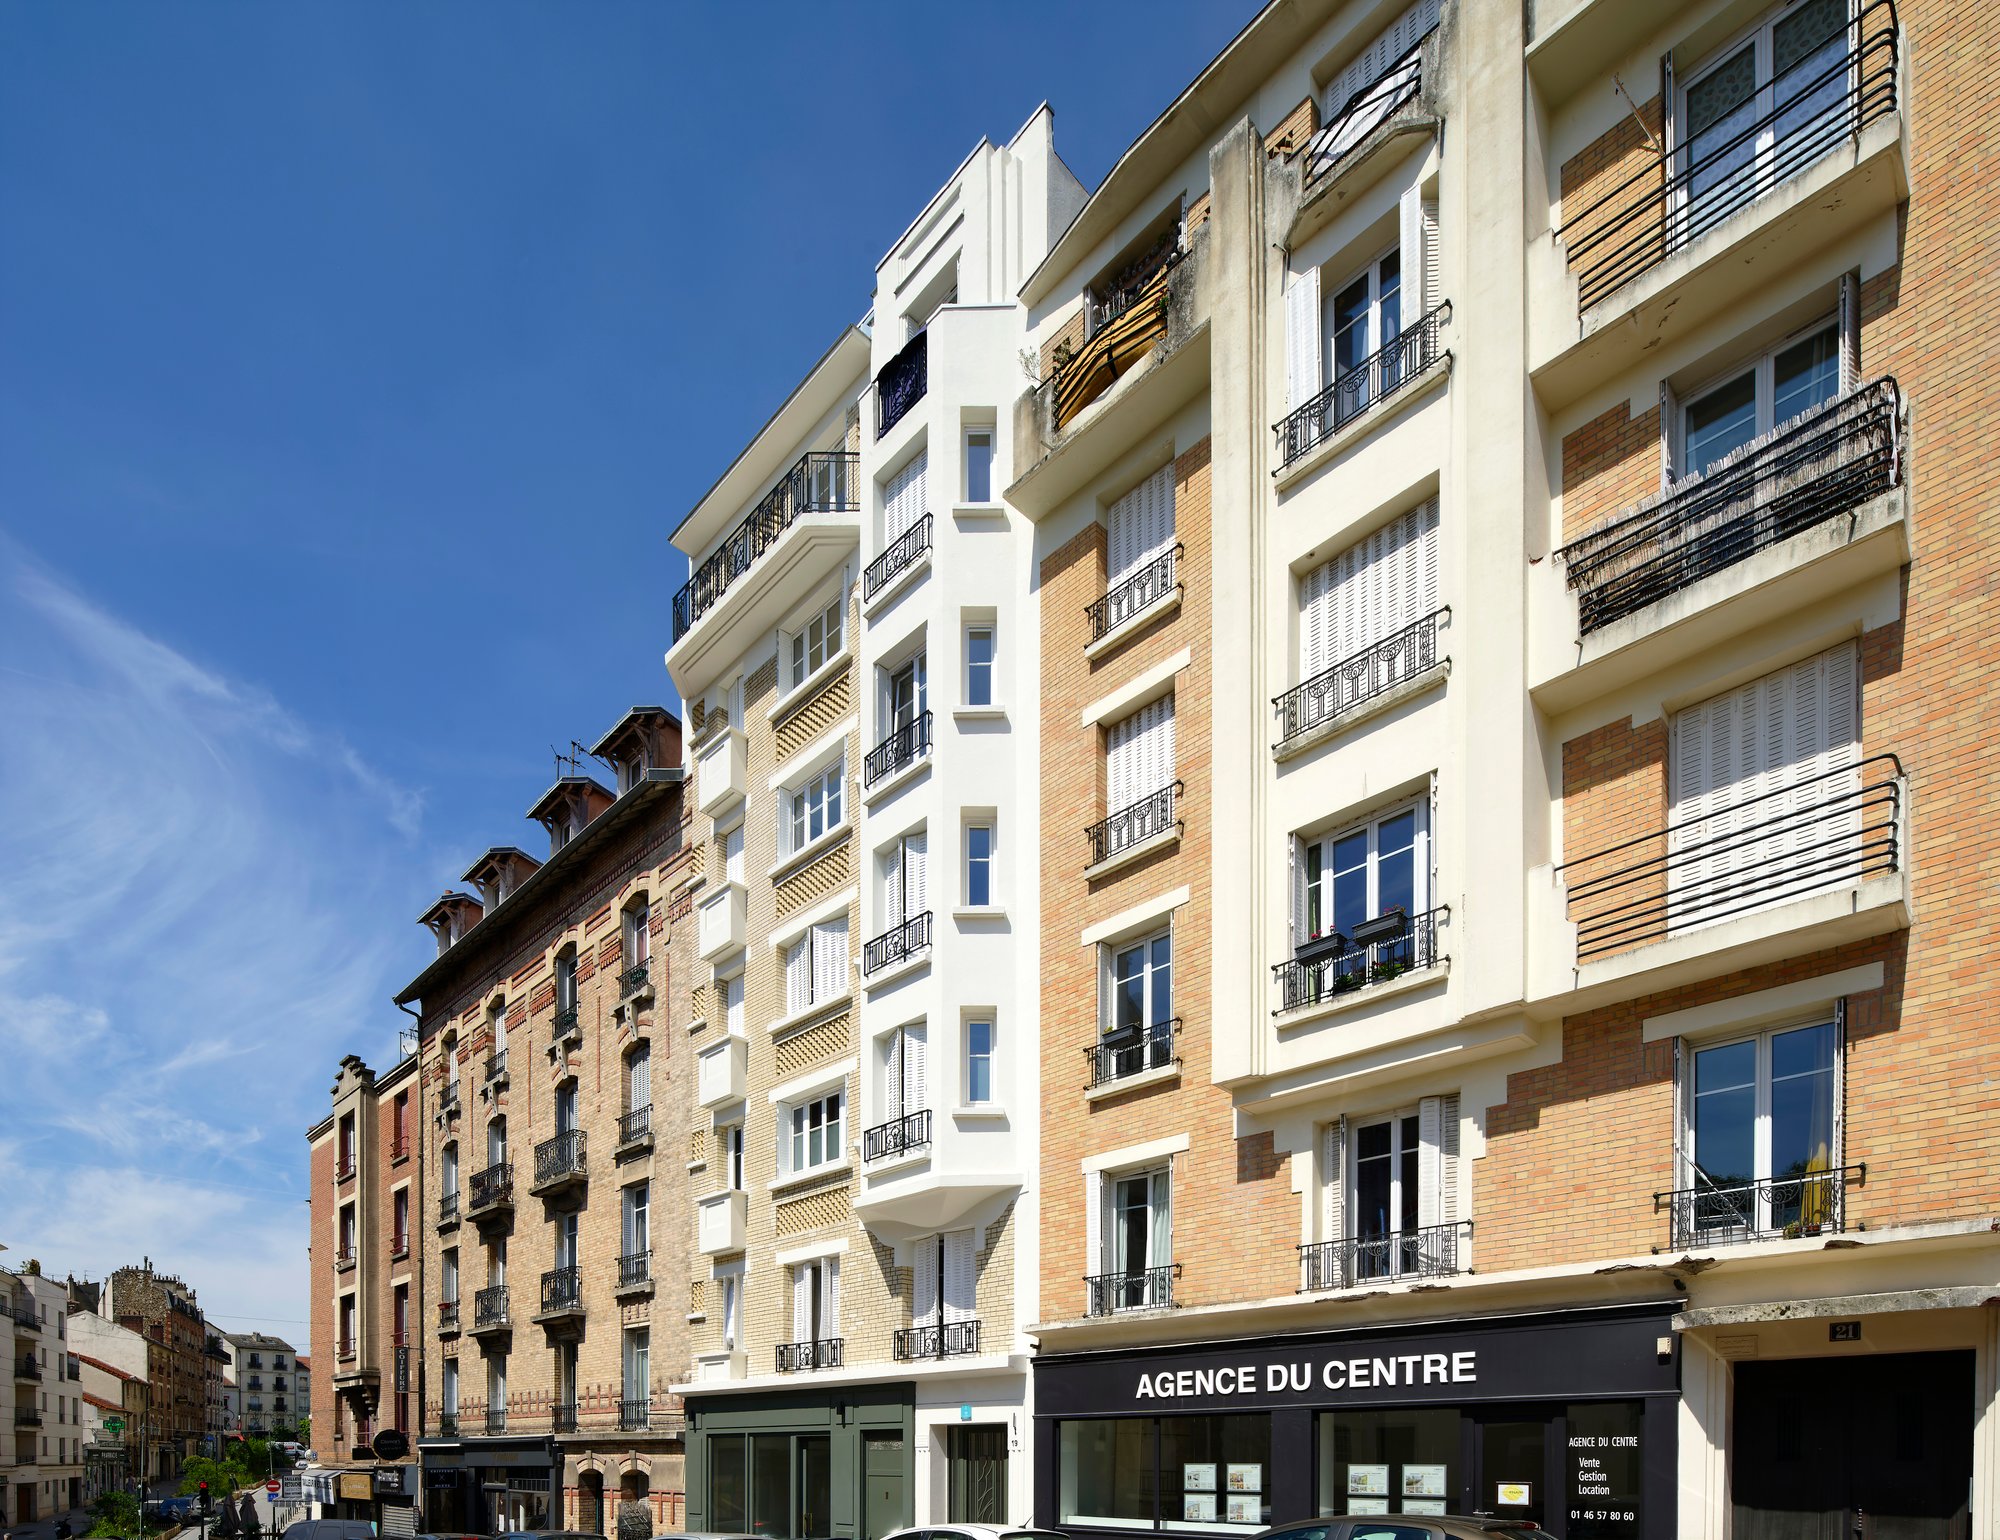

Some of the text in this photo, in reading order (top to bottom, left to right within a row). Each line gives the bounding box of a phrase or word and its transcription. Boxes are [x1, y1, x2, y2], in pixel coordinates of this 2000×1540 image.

[1835, 1324, 1855, 1339] 21
[1135, 1351, 1478, 1399] AGENCE DU CENTRE
[1011, 1439, 1019, 1447] 19
[1568, 1436, 1638, 1448] AGENCE DU CENTRE
[1578, 1457, 1601, 1468] Vente
[1578, 1470, 1607, 1482] Gestion
[1578, 1484, 1610, 1496] Location
[1570, 1509, 1635, 1521] 01 46 57 80 60
